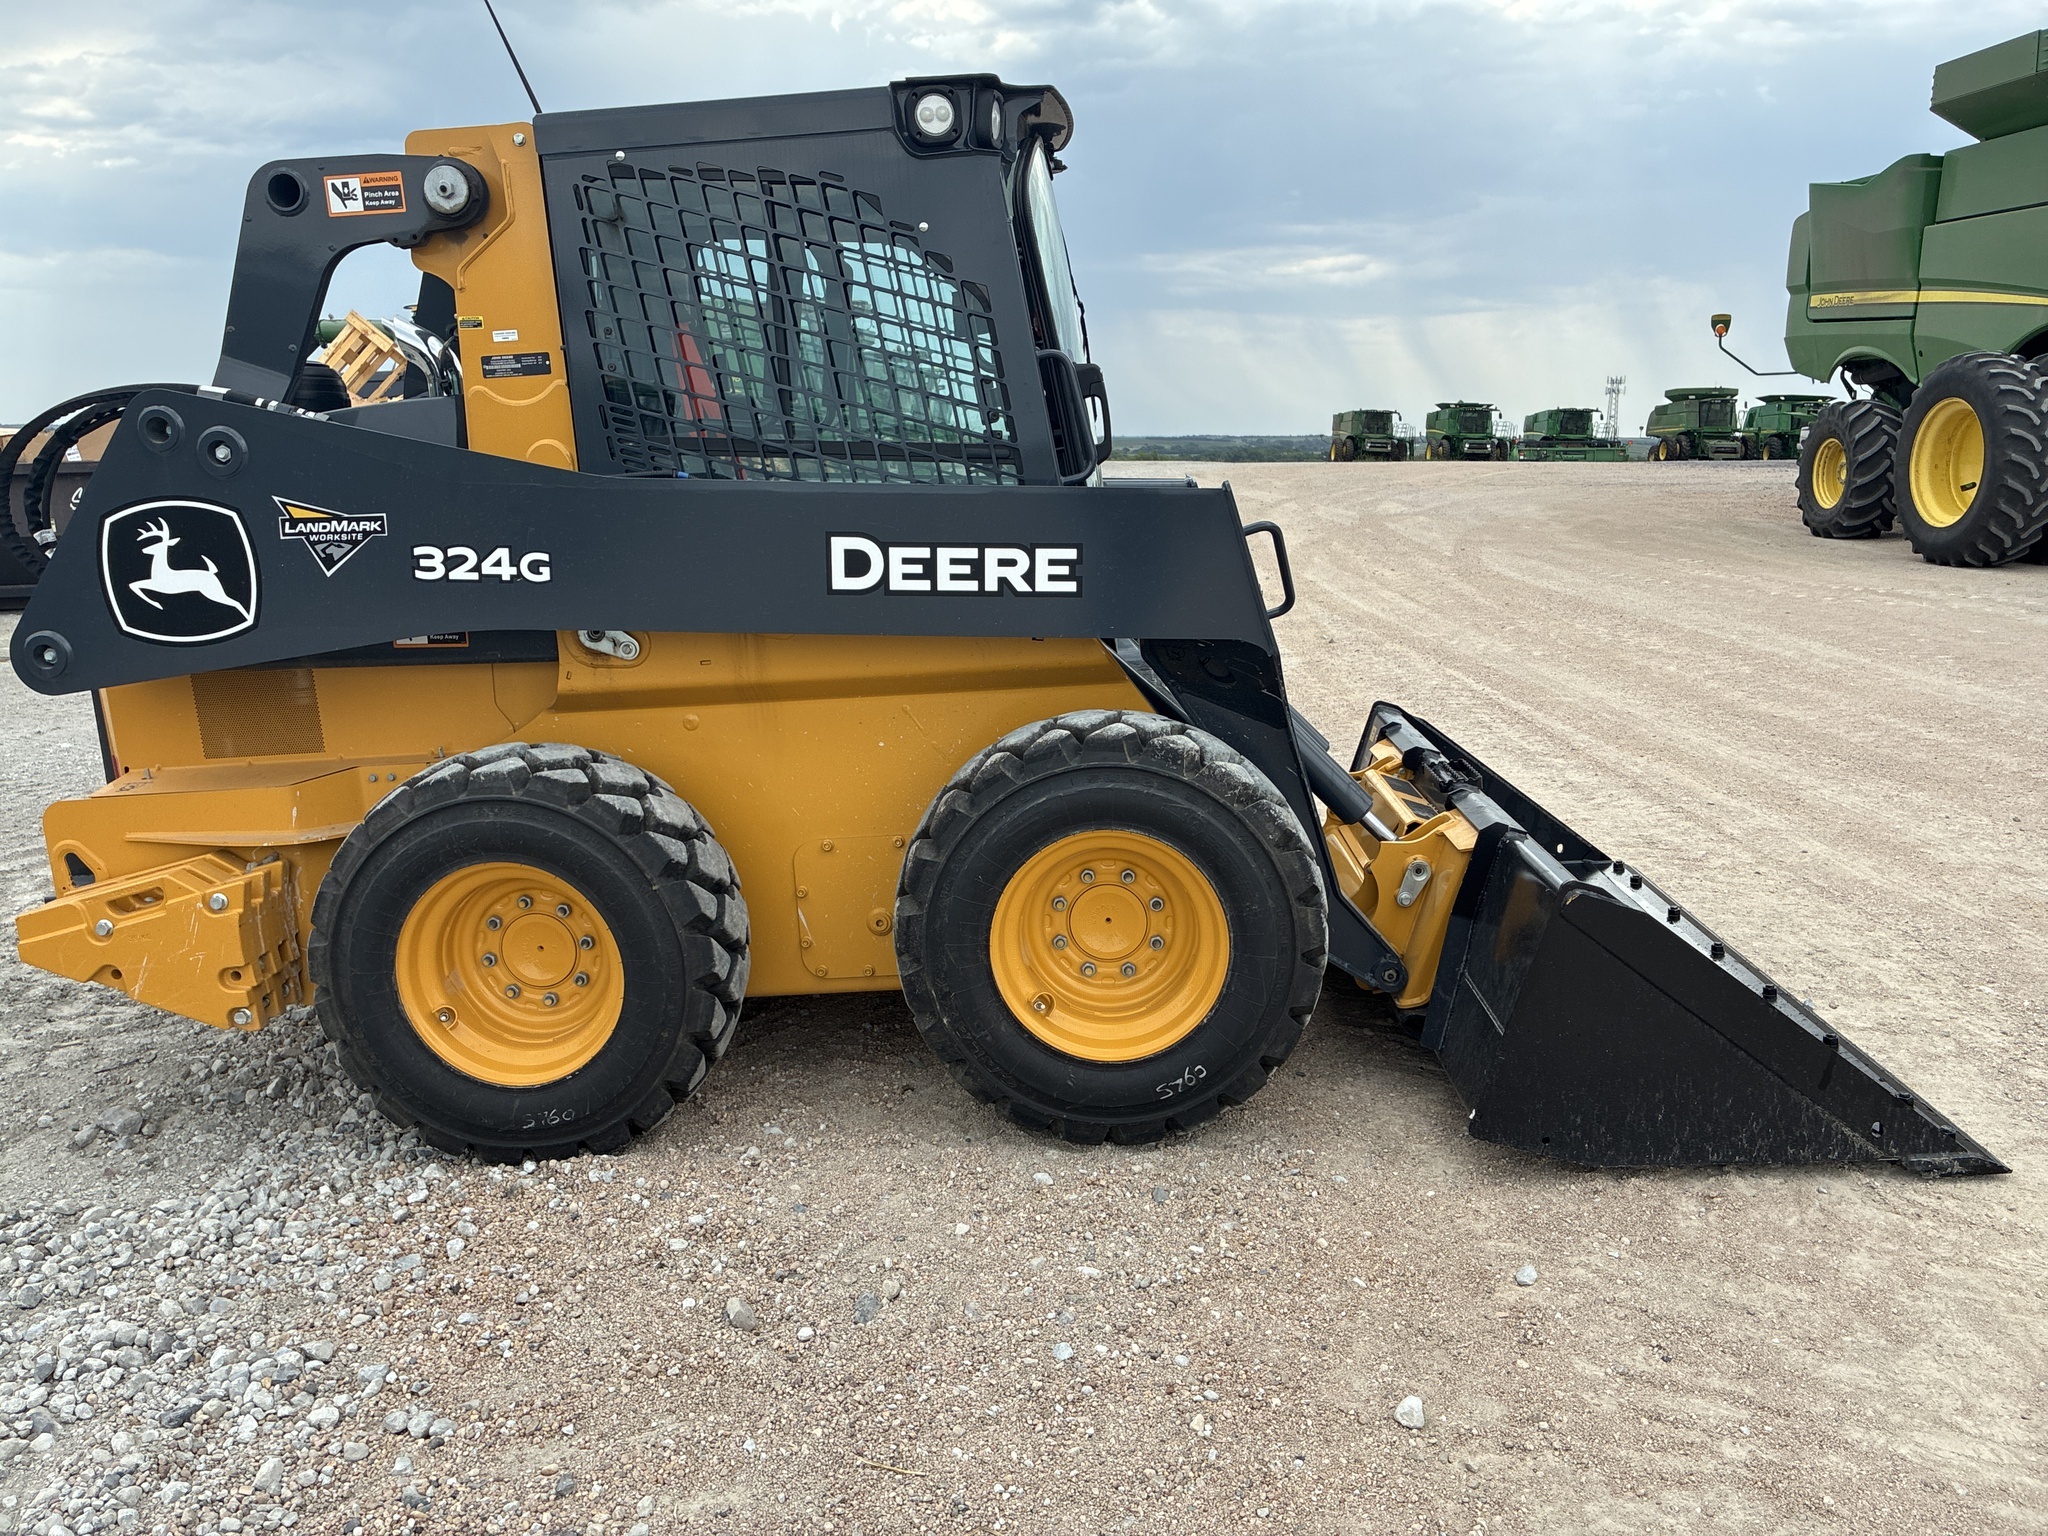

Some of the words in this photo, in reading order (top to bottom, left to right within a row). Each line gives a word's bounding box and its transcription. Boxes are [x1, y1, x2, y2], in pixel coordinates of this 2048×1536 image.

[368, 175, 399, 184] WARNING
[364, 190, 383, 198] Pinch
[1817, 296, 1834, 308] JOHN
[1834, 295, 1855, 306] DEERE
[309, 533, 364, 542] WORKSITE
[413, 545, 551, 583] 324G
[830, 536, 1078, 593] DEERE
[444, 633, 459, 641] Away
